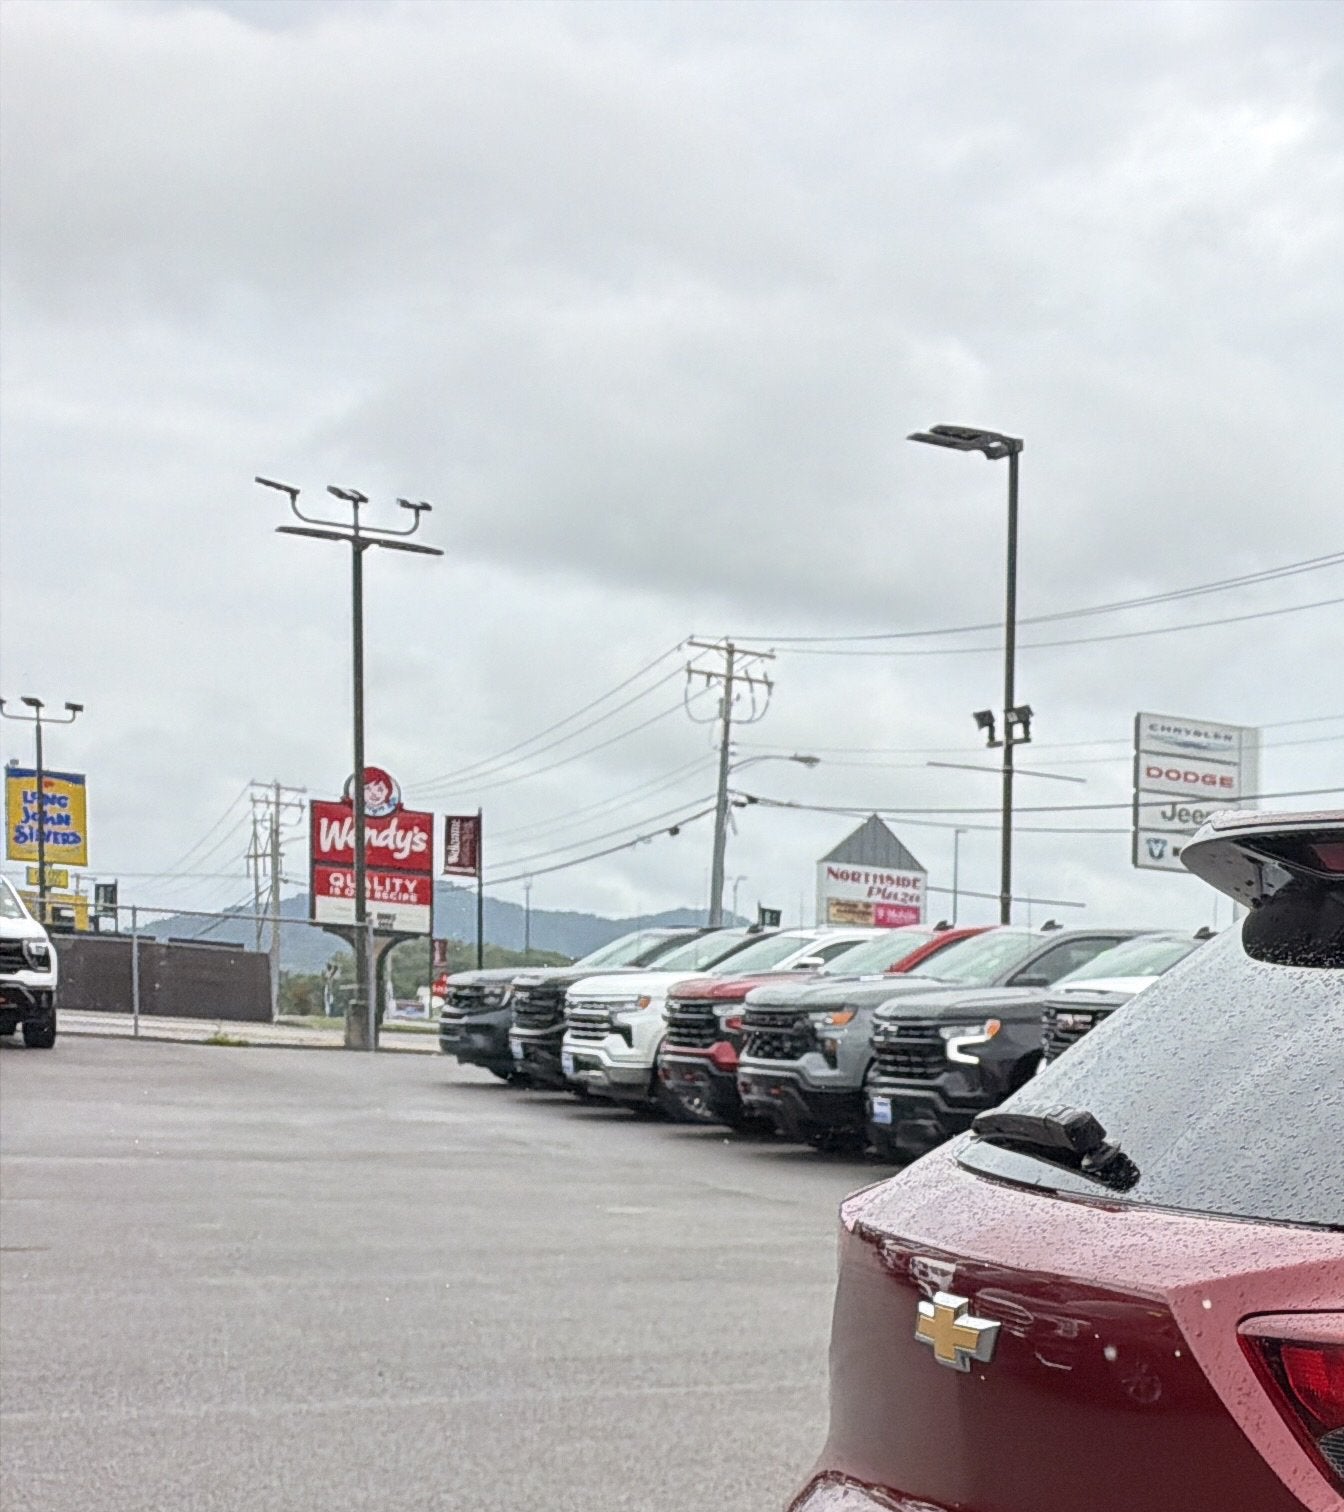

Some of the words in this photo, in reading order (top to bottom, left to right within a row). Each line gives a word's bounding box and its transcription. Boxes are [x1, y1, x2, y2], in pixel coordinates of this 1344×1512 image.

[1148, 723, 1233, 742] CHRYSLER
[1146, 766, 1233, 788] DODGE
[1160, 803, 1213, 824] Jee
